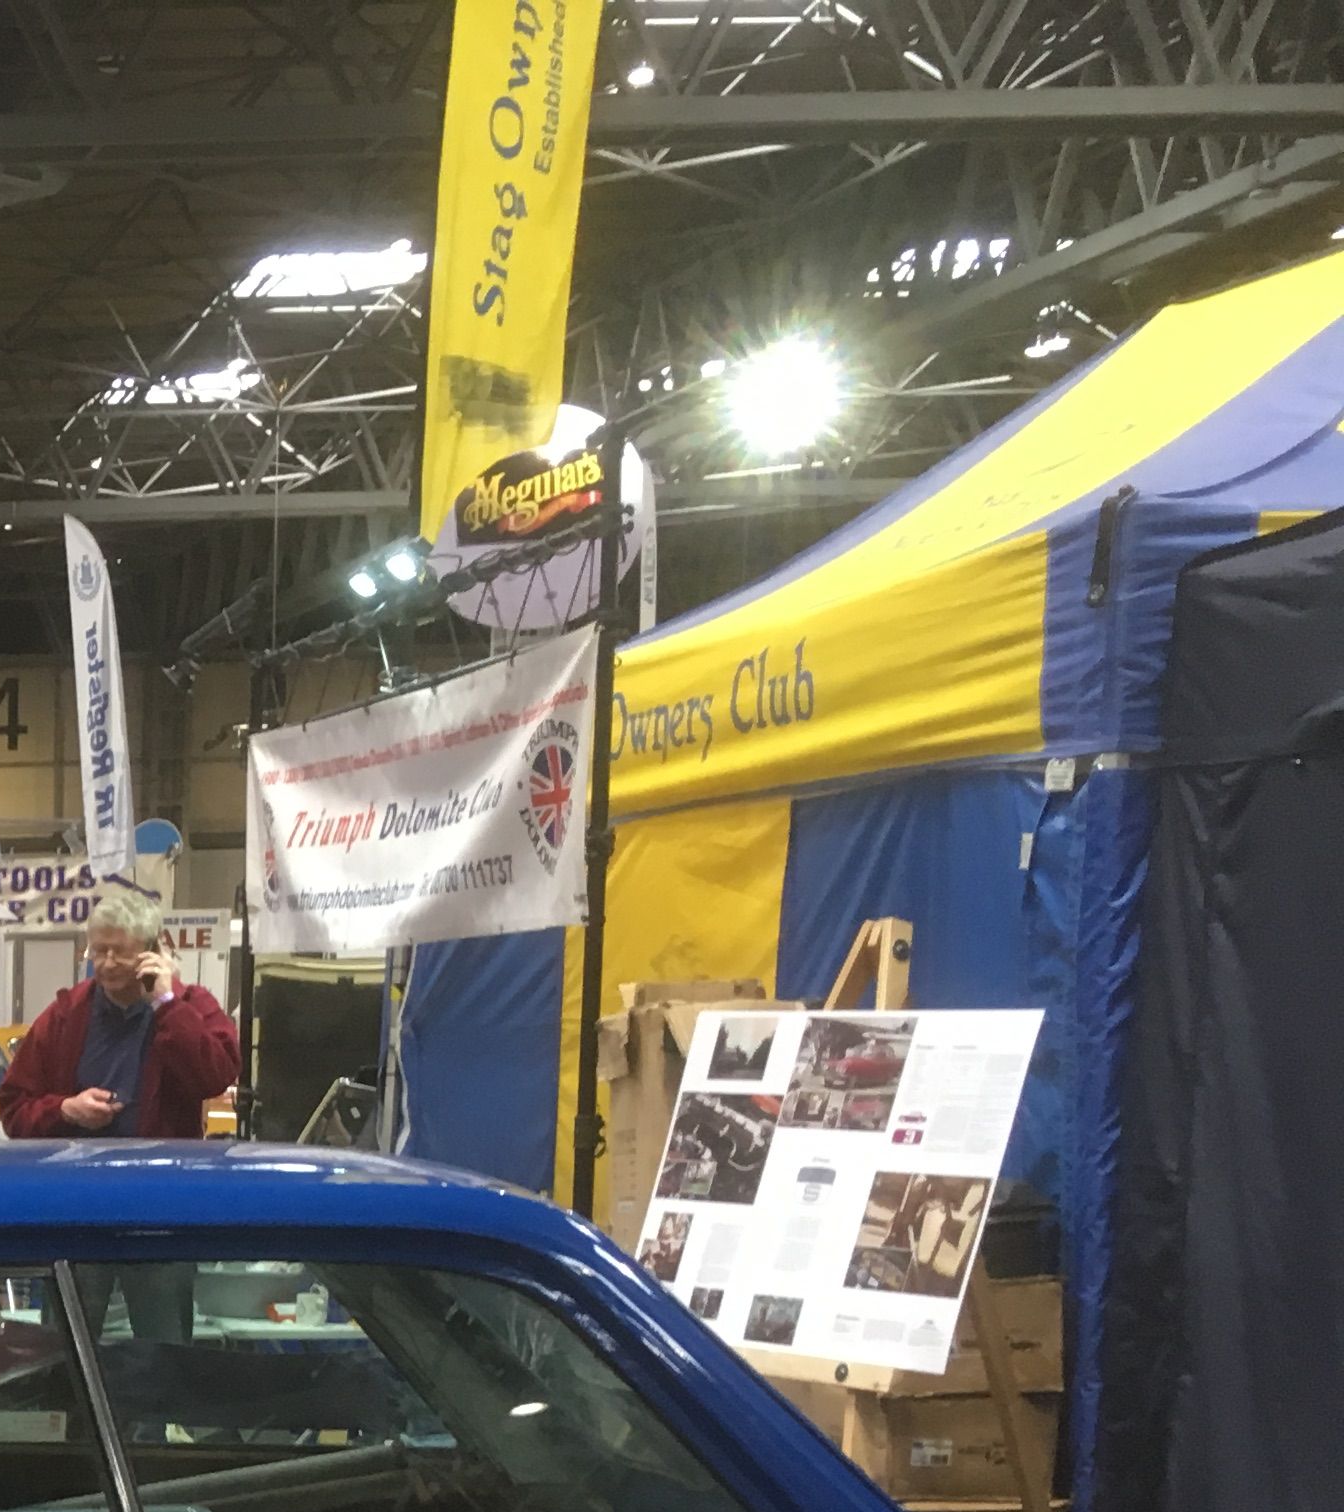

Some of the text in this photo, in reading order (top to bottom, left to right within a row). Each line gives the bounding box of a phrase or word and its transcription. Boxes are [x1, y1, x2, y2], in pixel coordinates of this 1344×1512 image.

[472, 181, 528, 328] Stag
[730, 636, 814, 734] Club
[286, 802, 376, 853] Triumph
[379, 789, 467, 840] Dolomite
[159, 927, 212, 950] ALE
